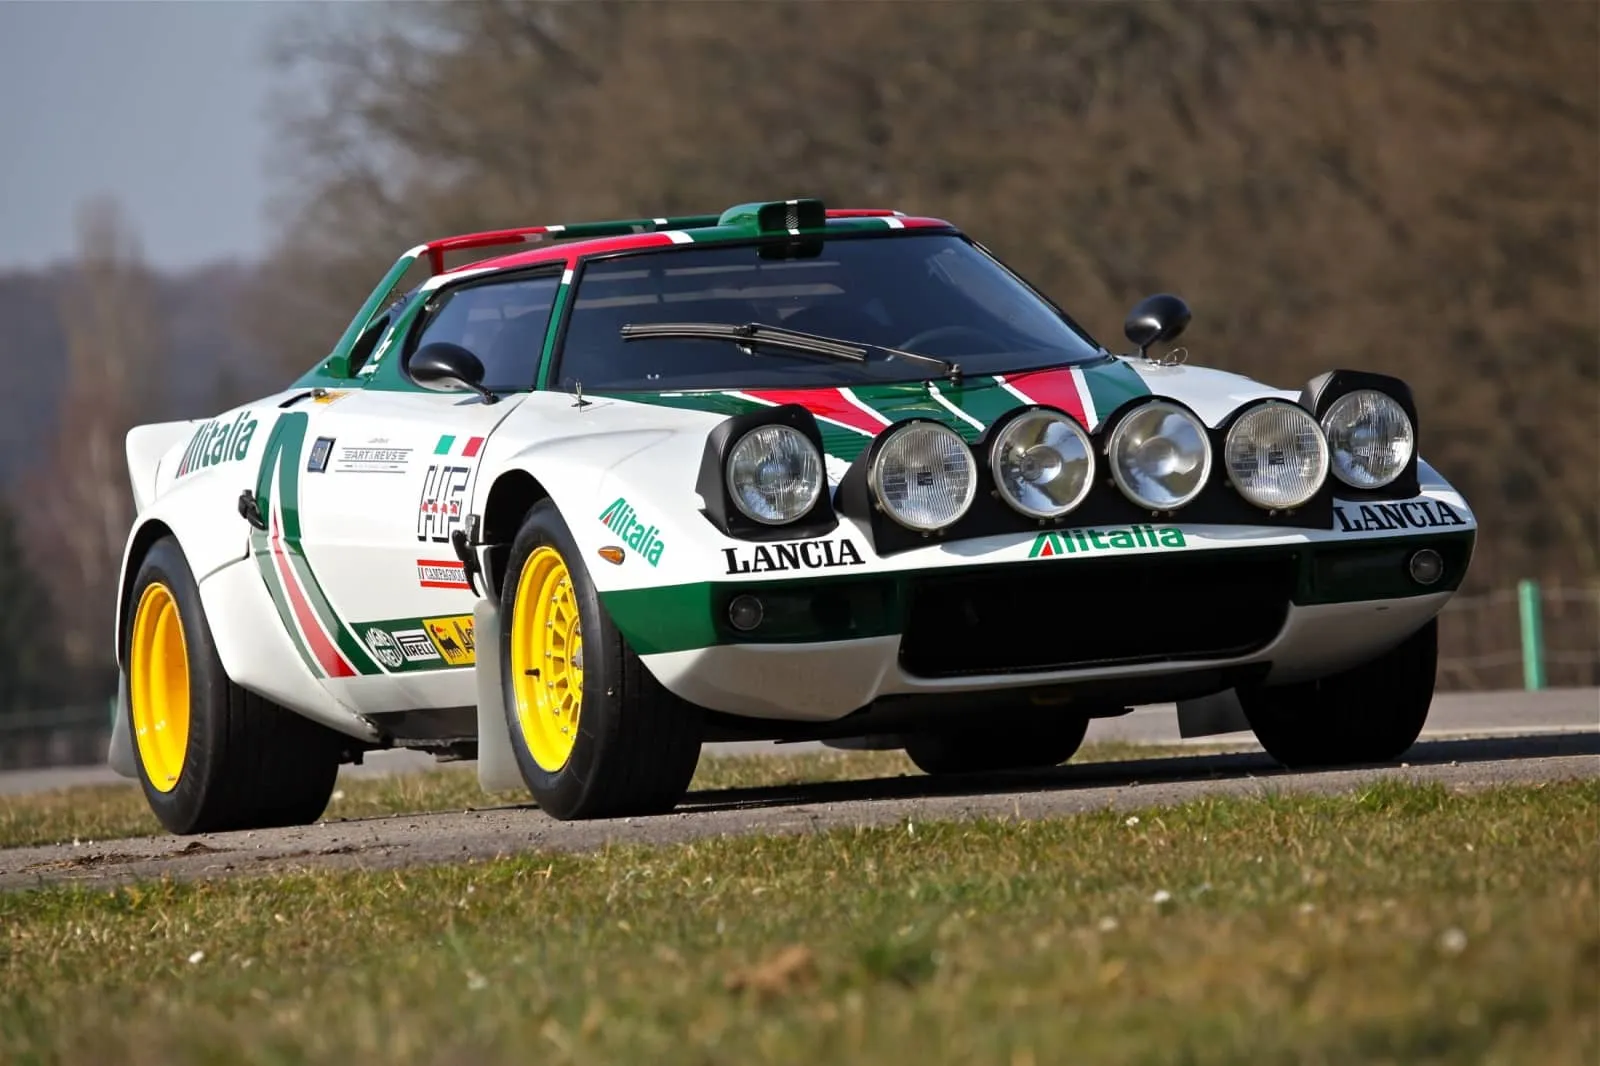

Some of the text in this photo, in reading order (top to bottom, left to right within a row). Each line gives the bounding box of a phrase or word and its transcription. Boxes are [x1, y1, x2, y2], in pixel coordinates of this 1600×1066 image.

[175, 410, 258, 479] Alitalia
[418, 465, 471, 543] HF
[1333, 501, 1466, 532] LANCIA
[598, 497, 665, 568] Alitalia
[1028, 525, 1186, 558] Alitalia
[721, 539, 866, 575] LANCIA
[397, 634, 438, 657] PIRELLI
